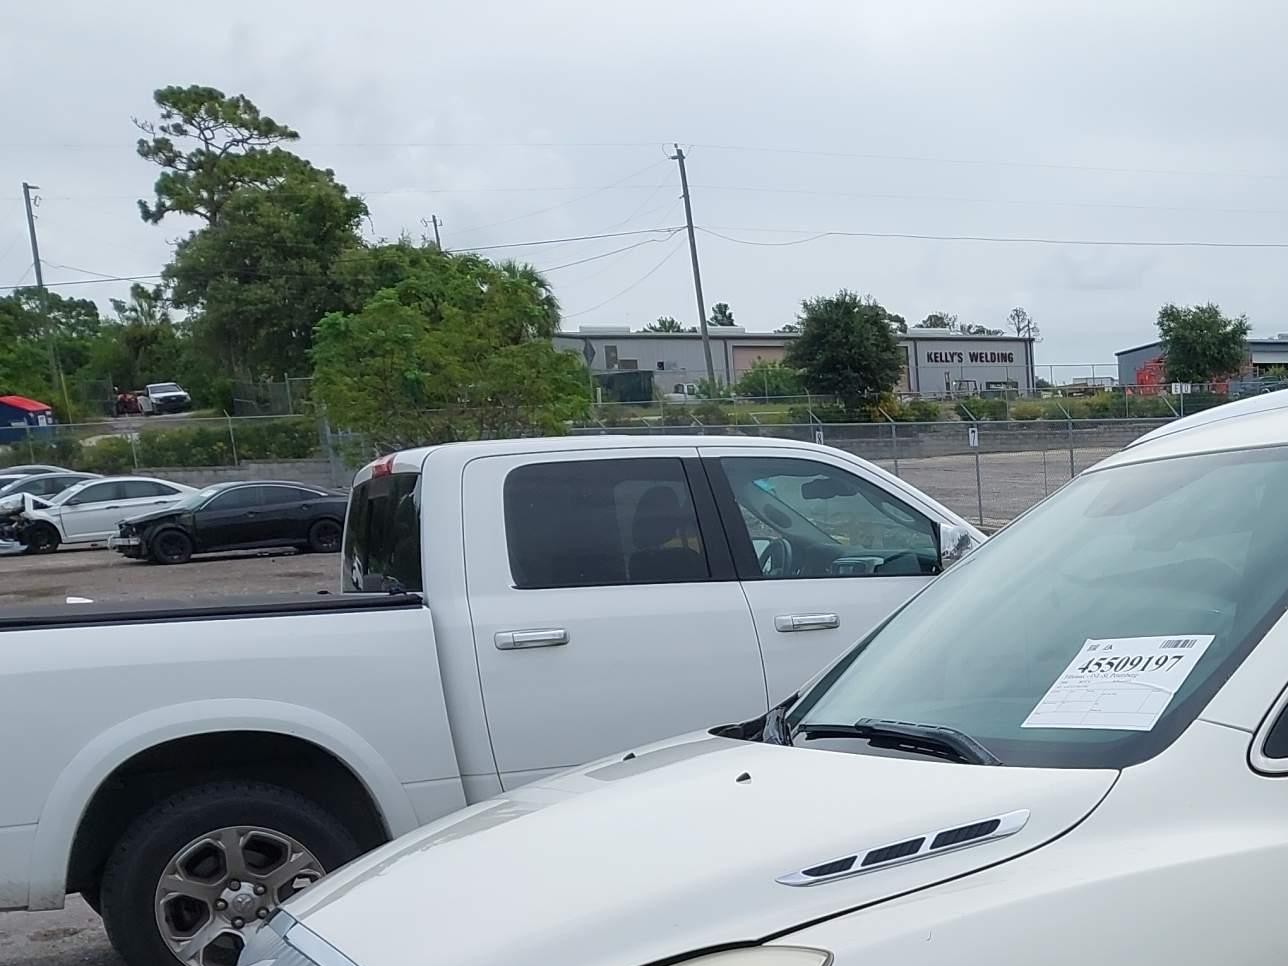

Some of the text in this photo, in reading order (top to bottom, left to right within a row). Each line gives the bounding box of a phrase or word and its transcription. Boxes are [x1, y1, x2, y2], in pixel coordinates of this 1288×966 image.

[926, 351, 1014, 363] KELLY'S WELDING
[1078, 654, 1185, 674] 45509197
